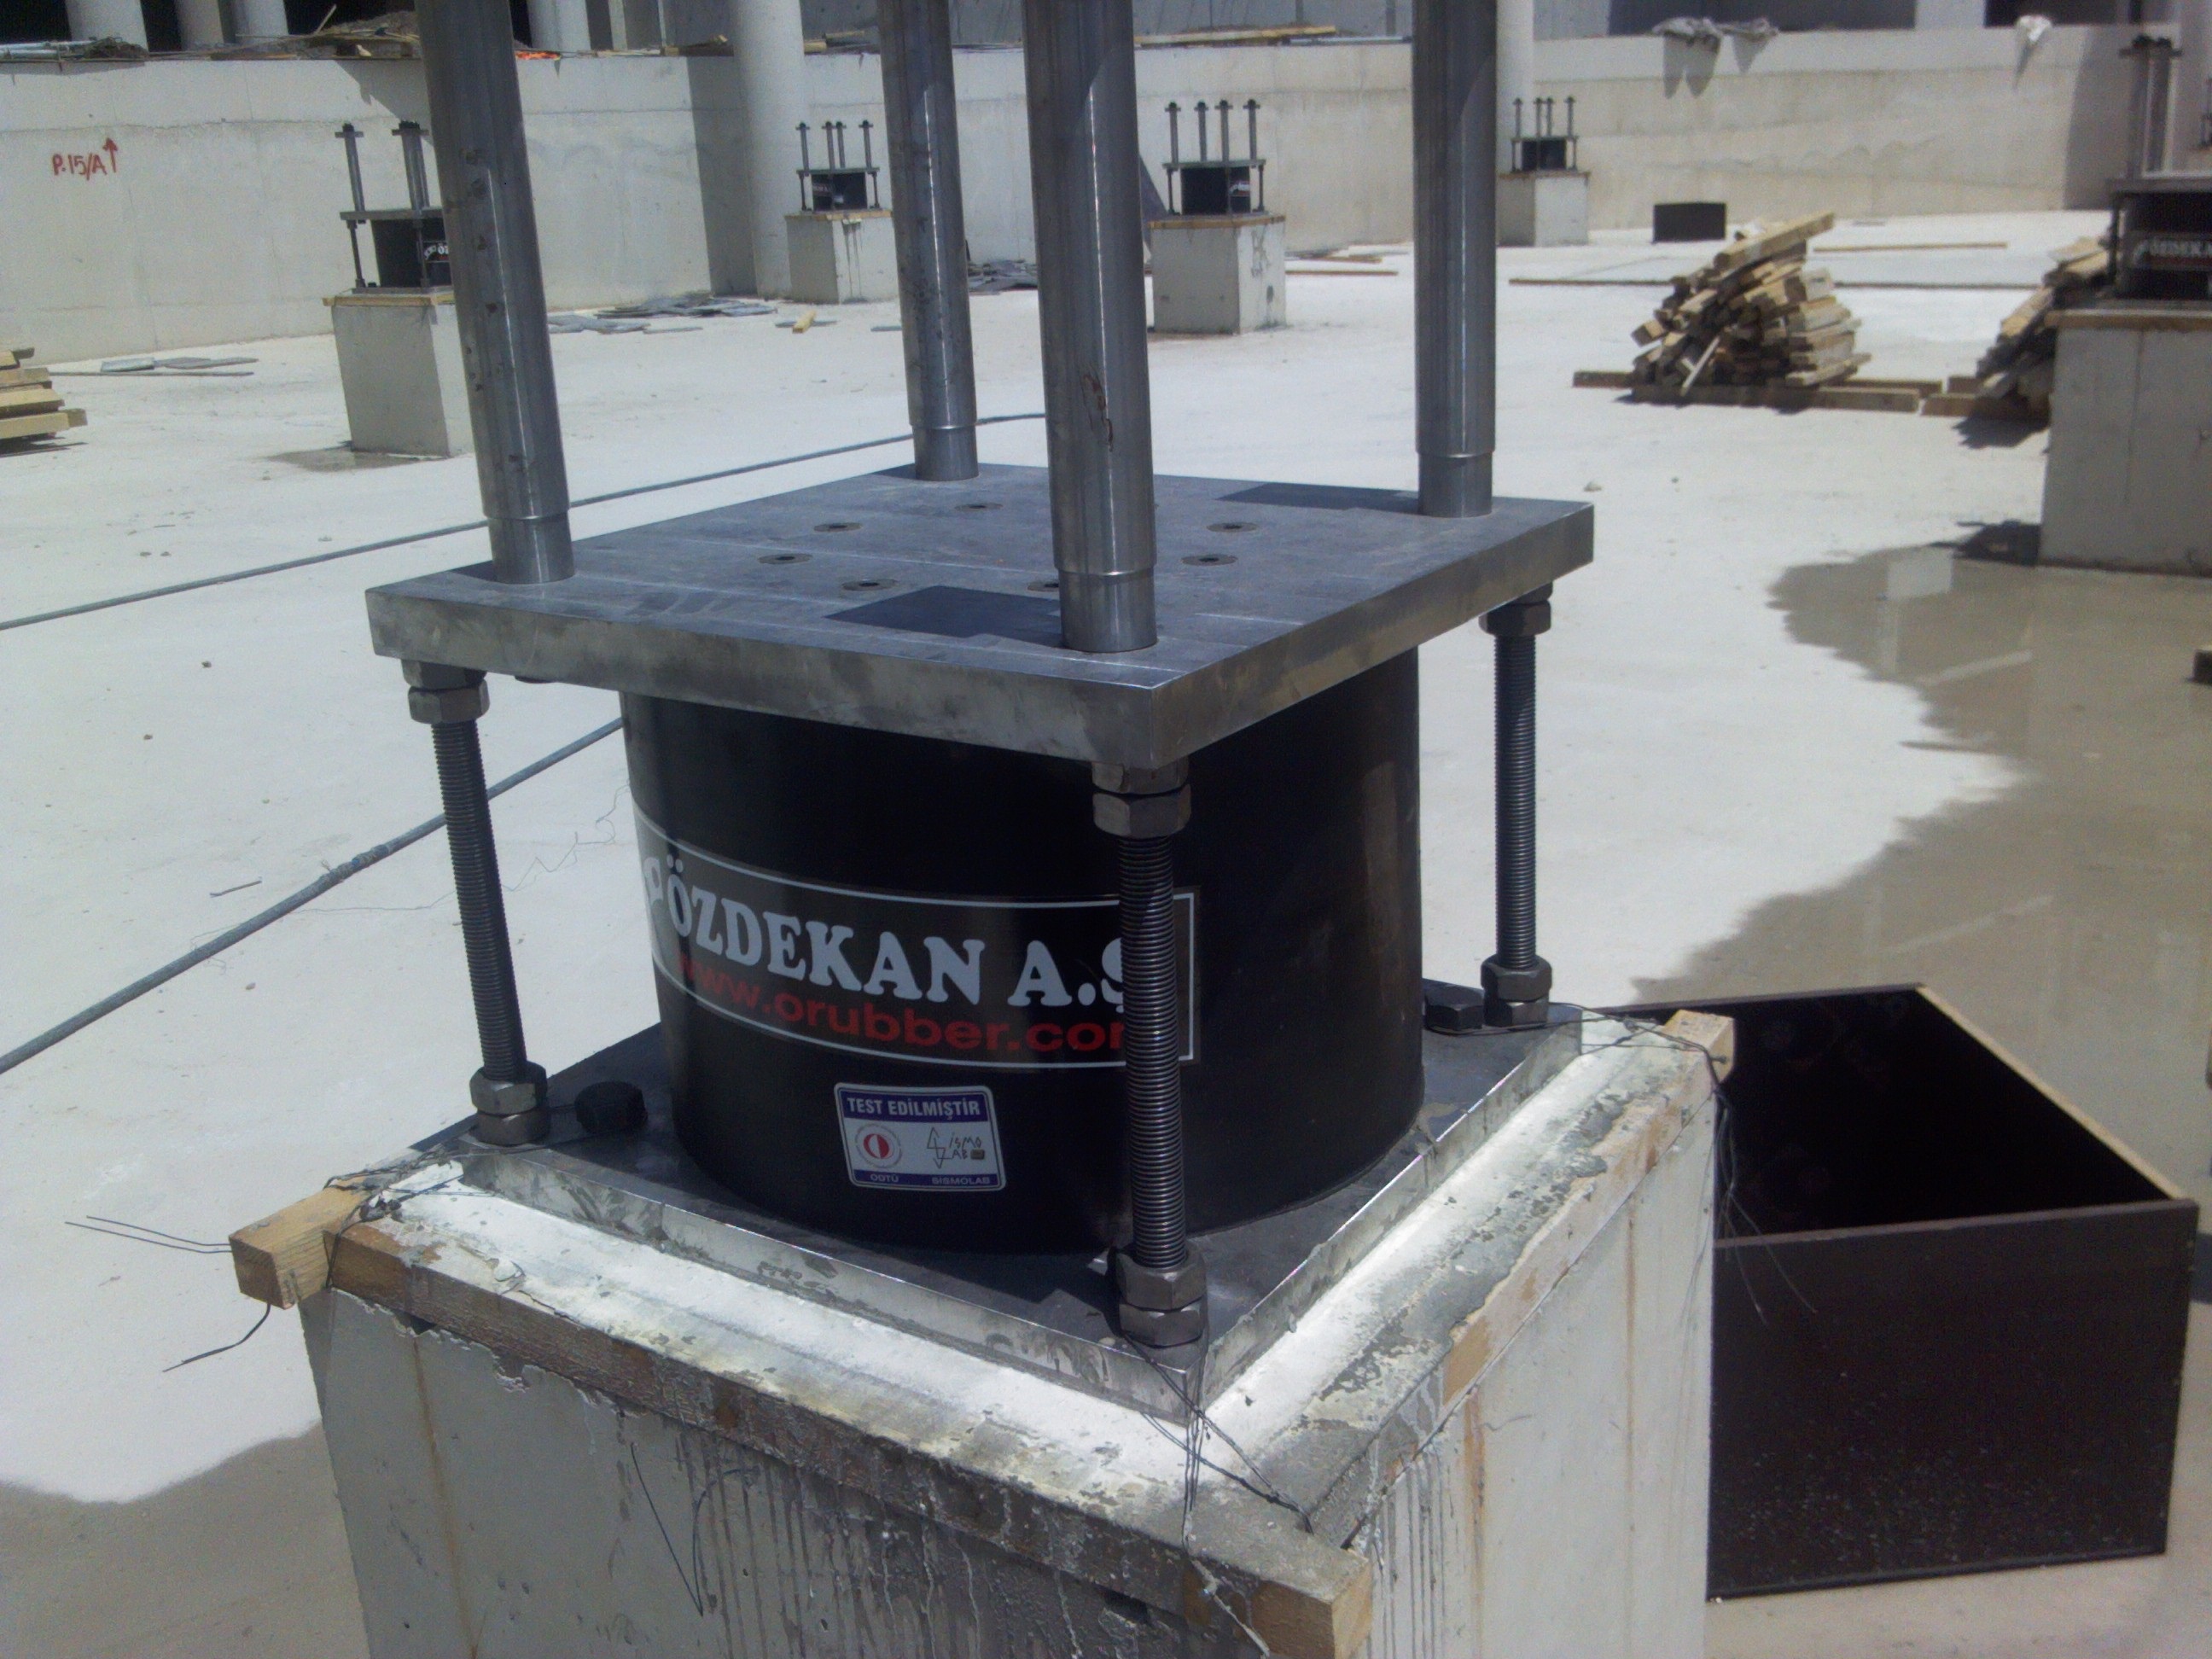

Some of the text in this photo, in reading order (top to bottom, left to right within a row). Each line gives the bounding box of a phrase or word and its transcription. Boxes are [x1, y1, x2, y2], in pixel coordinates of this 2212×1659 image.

[664, 854, 985, 1004] ÖZDEKAN
[847, 1097, 981, 1121] TEST EDİLMİŞTİR
